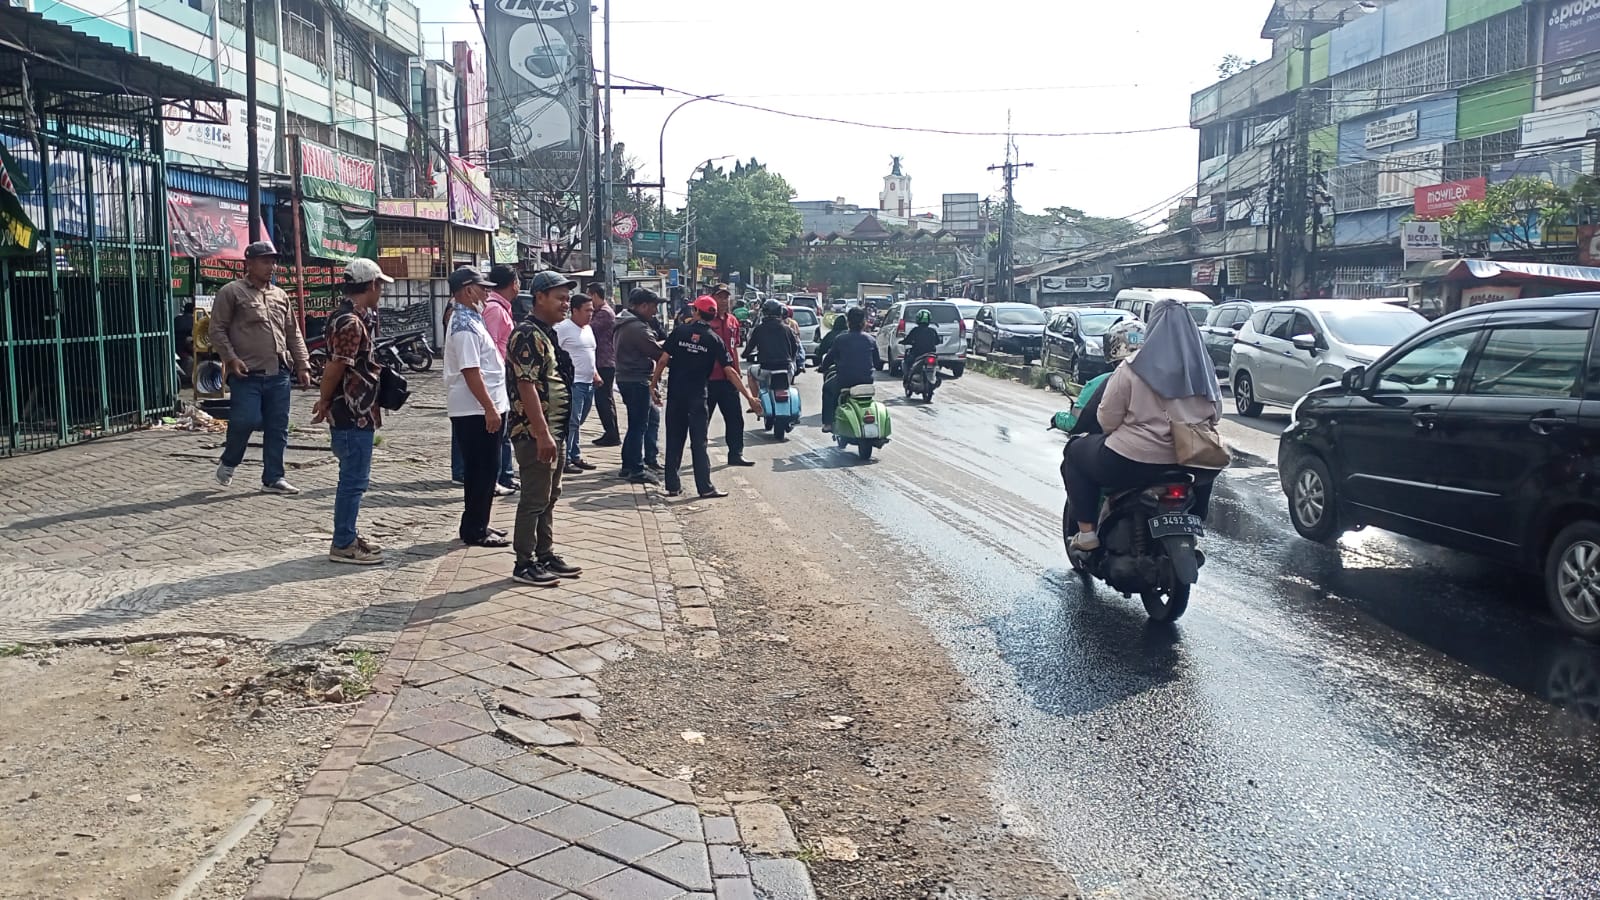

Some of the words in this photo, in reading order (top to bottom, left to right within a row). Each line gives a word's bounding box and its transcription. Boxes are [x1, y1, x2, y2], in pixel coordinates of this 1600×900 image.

[301, 142, 337, 183] MINA
[337, 153, 376, 192] MOTOR
[678, 340, 708, 353] BARCELONA
[1162, 516, 1185, 525] 3492
